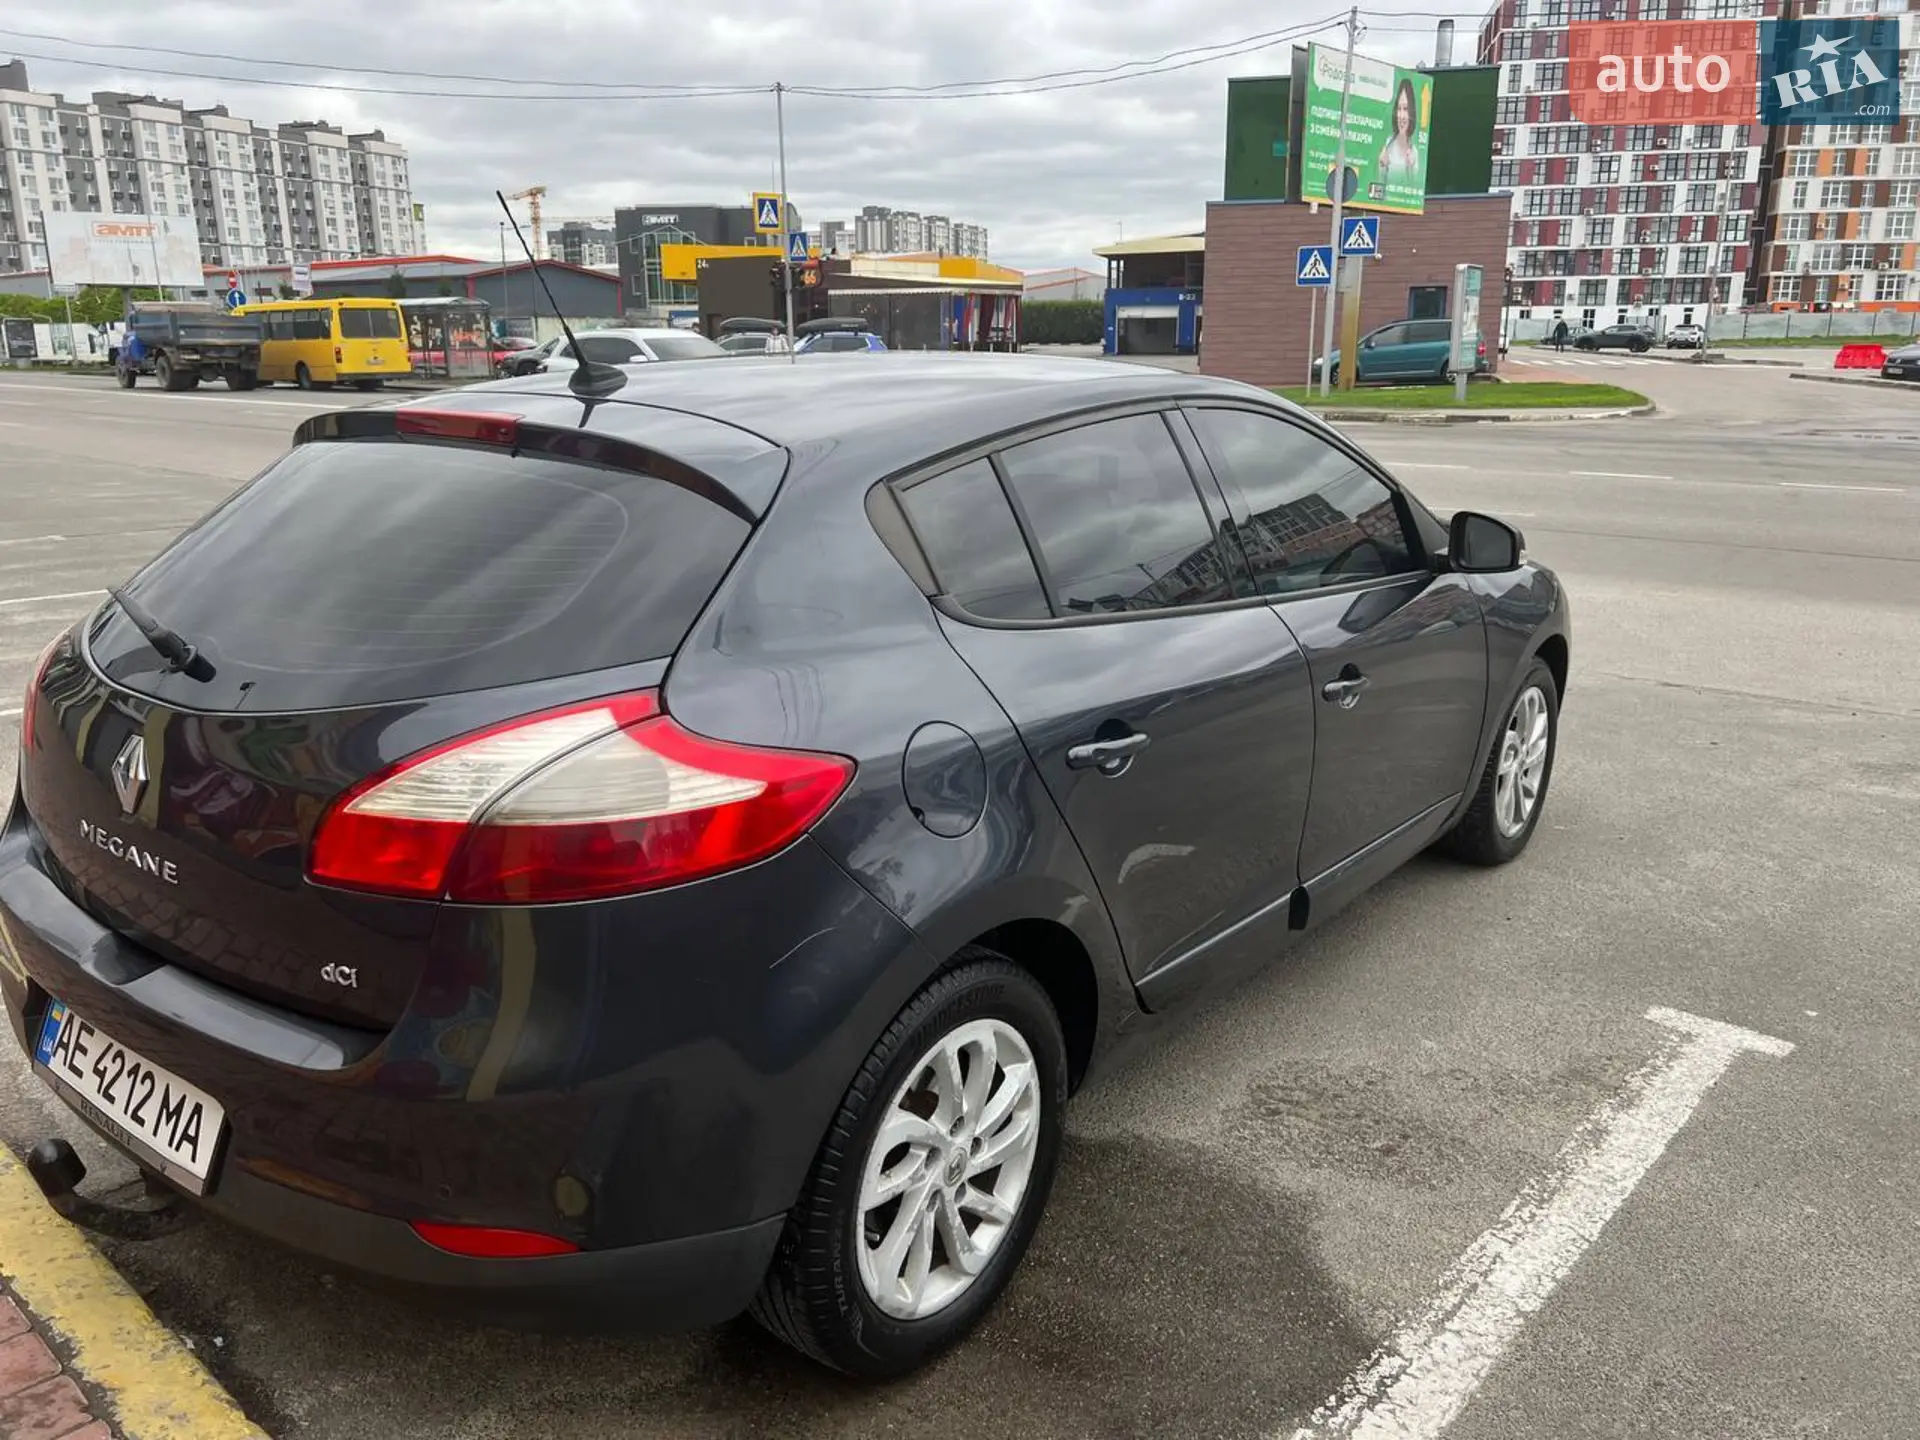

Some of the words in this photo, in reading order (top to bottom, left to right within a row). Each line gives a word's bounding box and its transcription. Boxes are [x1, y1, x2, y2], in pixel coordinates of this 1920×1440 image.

[80, 819, 179, 885] MEGANE
[53, 1012, 96, 1081] AE
[92, 1041, 156, 1129] 4212
[152, 1081, 204, 1164] MA
